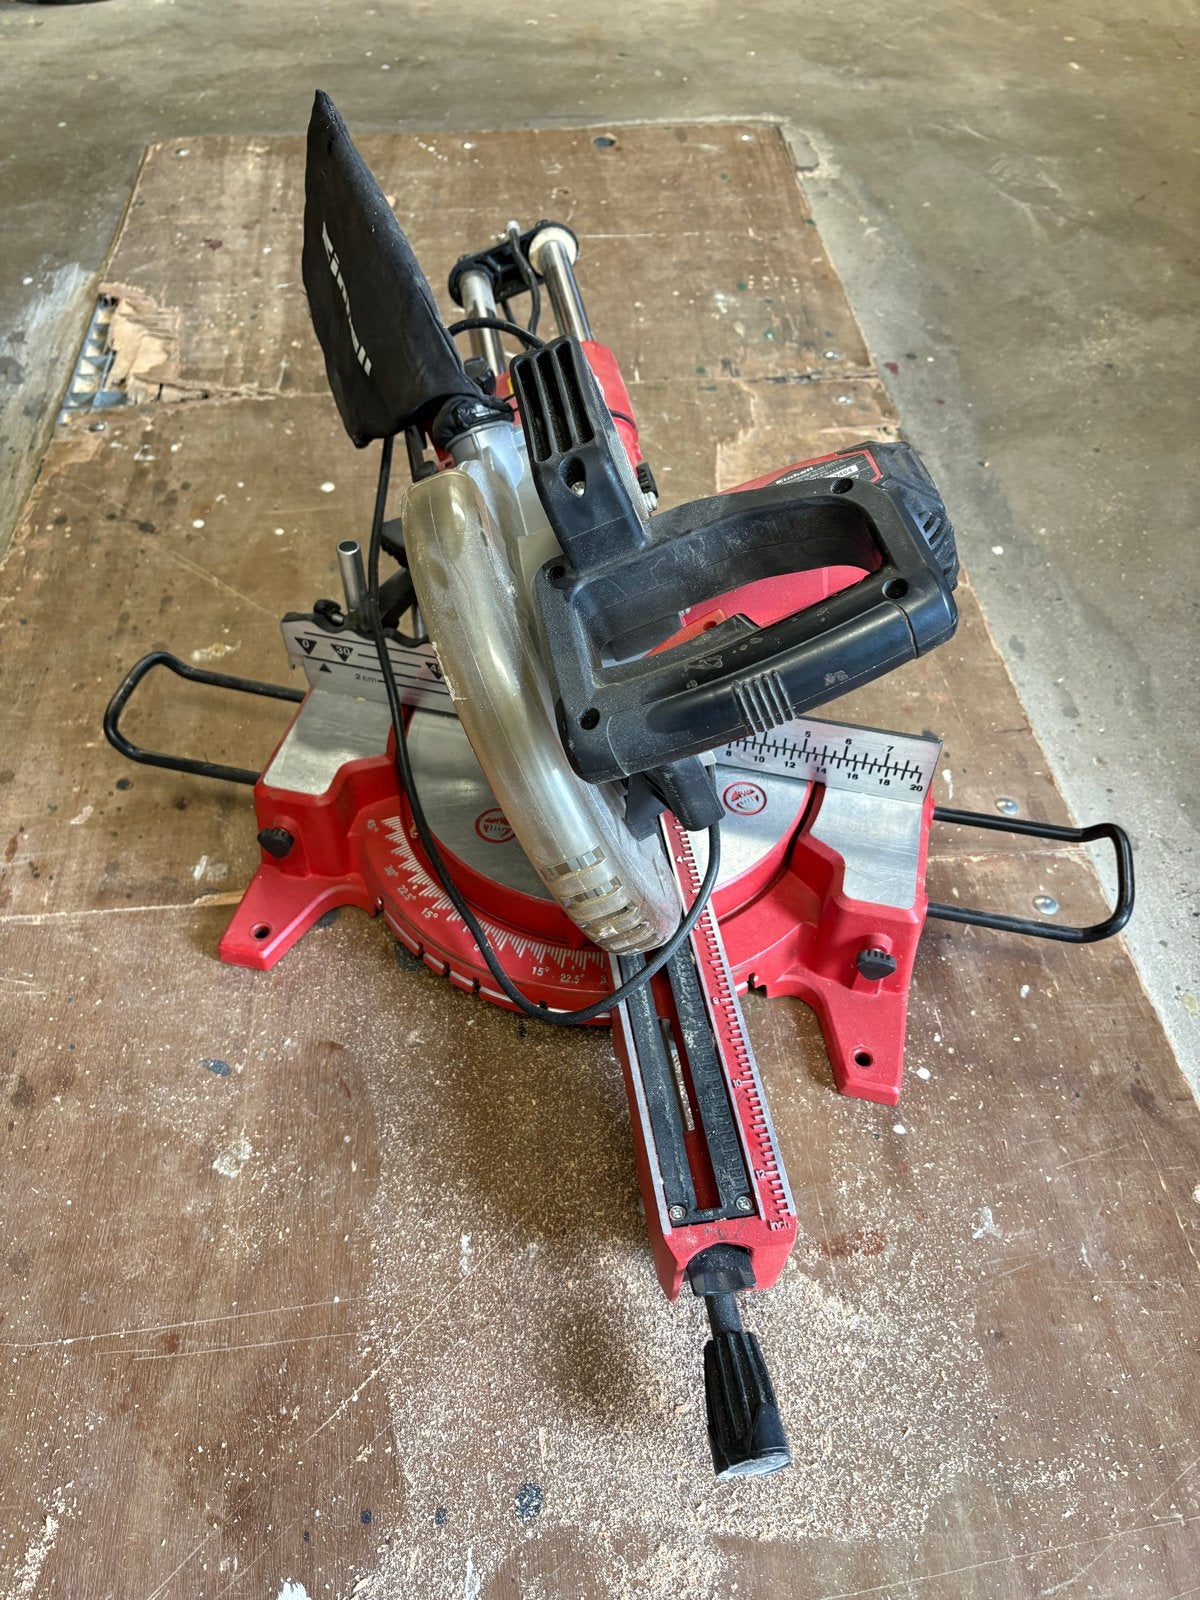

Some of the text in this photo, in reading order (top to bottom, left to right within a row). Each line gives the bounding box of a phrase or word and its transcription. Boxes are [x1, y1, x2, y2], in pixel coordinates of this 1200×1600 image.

[301, 639, 310, 649] 0
[335, 646, 351, 657] 30
[362, 675, 377, 683] cm
[804, 730, 812, 738] 5
[725, 749, 923, 792] 8 10 12 14 16 18 20
[532, 966, 550, 976] 15°
[560, 973, 585, 984] 22.5°
[733, 1079, 742, 1088] 10
[755, 1169, 766, 1179] 12
[769, 1219, 791, 1231] inch
